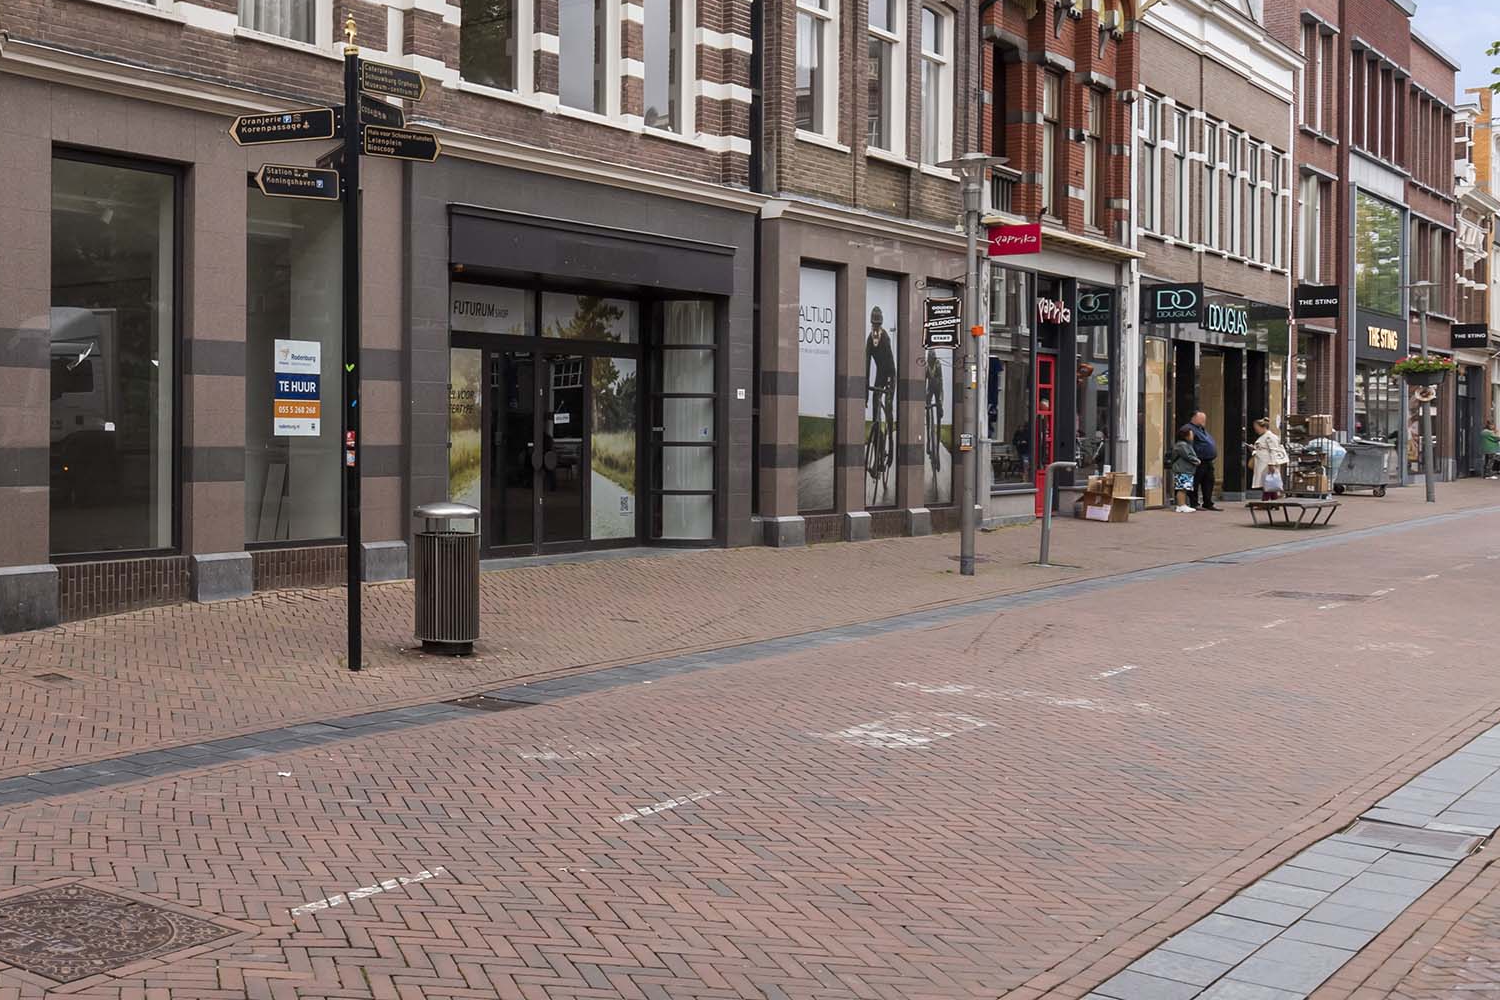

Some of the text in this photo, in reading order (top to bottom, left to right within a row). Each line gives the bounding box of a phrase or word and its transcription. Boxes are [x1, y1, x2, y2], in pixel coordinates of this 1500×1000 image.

[241, 116, 281, 126] Oranjerie
[241, 123, 302, 133] Korenpassage
[266, 167, 293, 176] Station
[266, 177, 315, 187] Koningshaven
[995, 234, 1037, 246] paprika
[1314, 298, 1338, 306] STING
[453, 300, 495, 318] FUTURUM
[1038, 297, 1071, 324] paprika
[1156, 310, 1197, 318] DOUGLAS
[799, 305, 833, 324] ALTIJD
[1208, 303, 1248, 336] DOUGLAS
[923, 318, 961, 328] APELDOORN
[1367, 326, 1398, 350] THE STING
[291, 354, 316, 362] Rodenburg
[279, 381, 317, 393] TE HUUR
